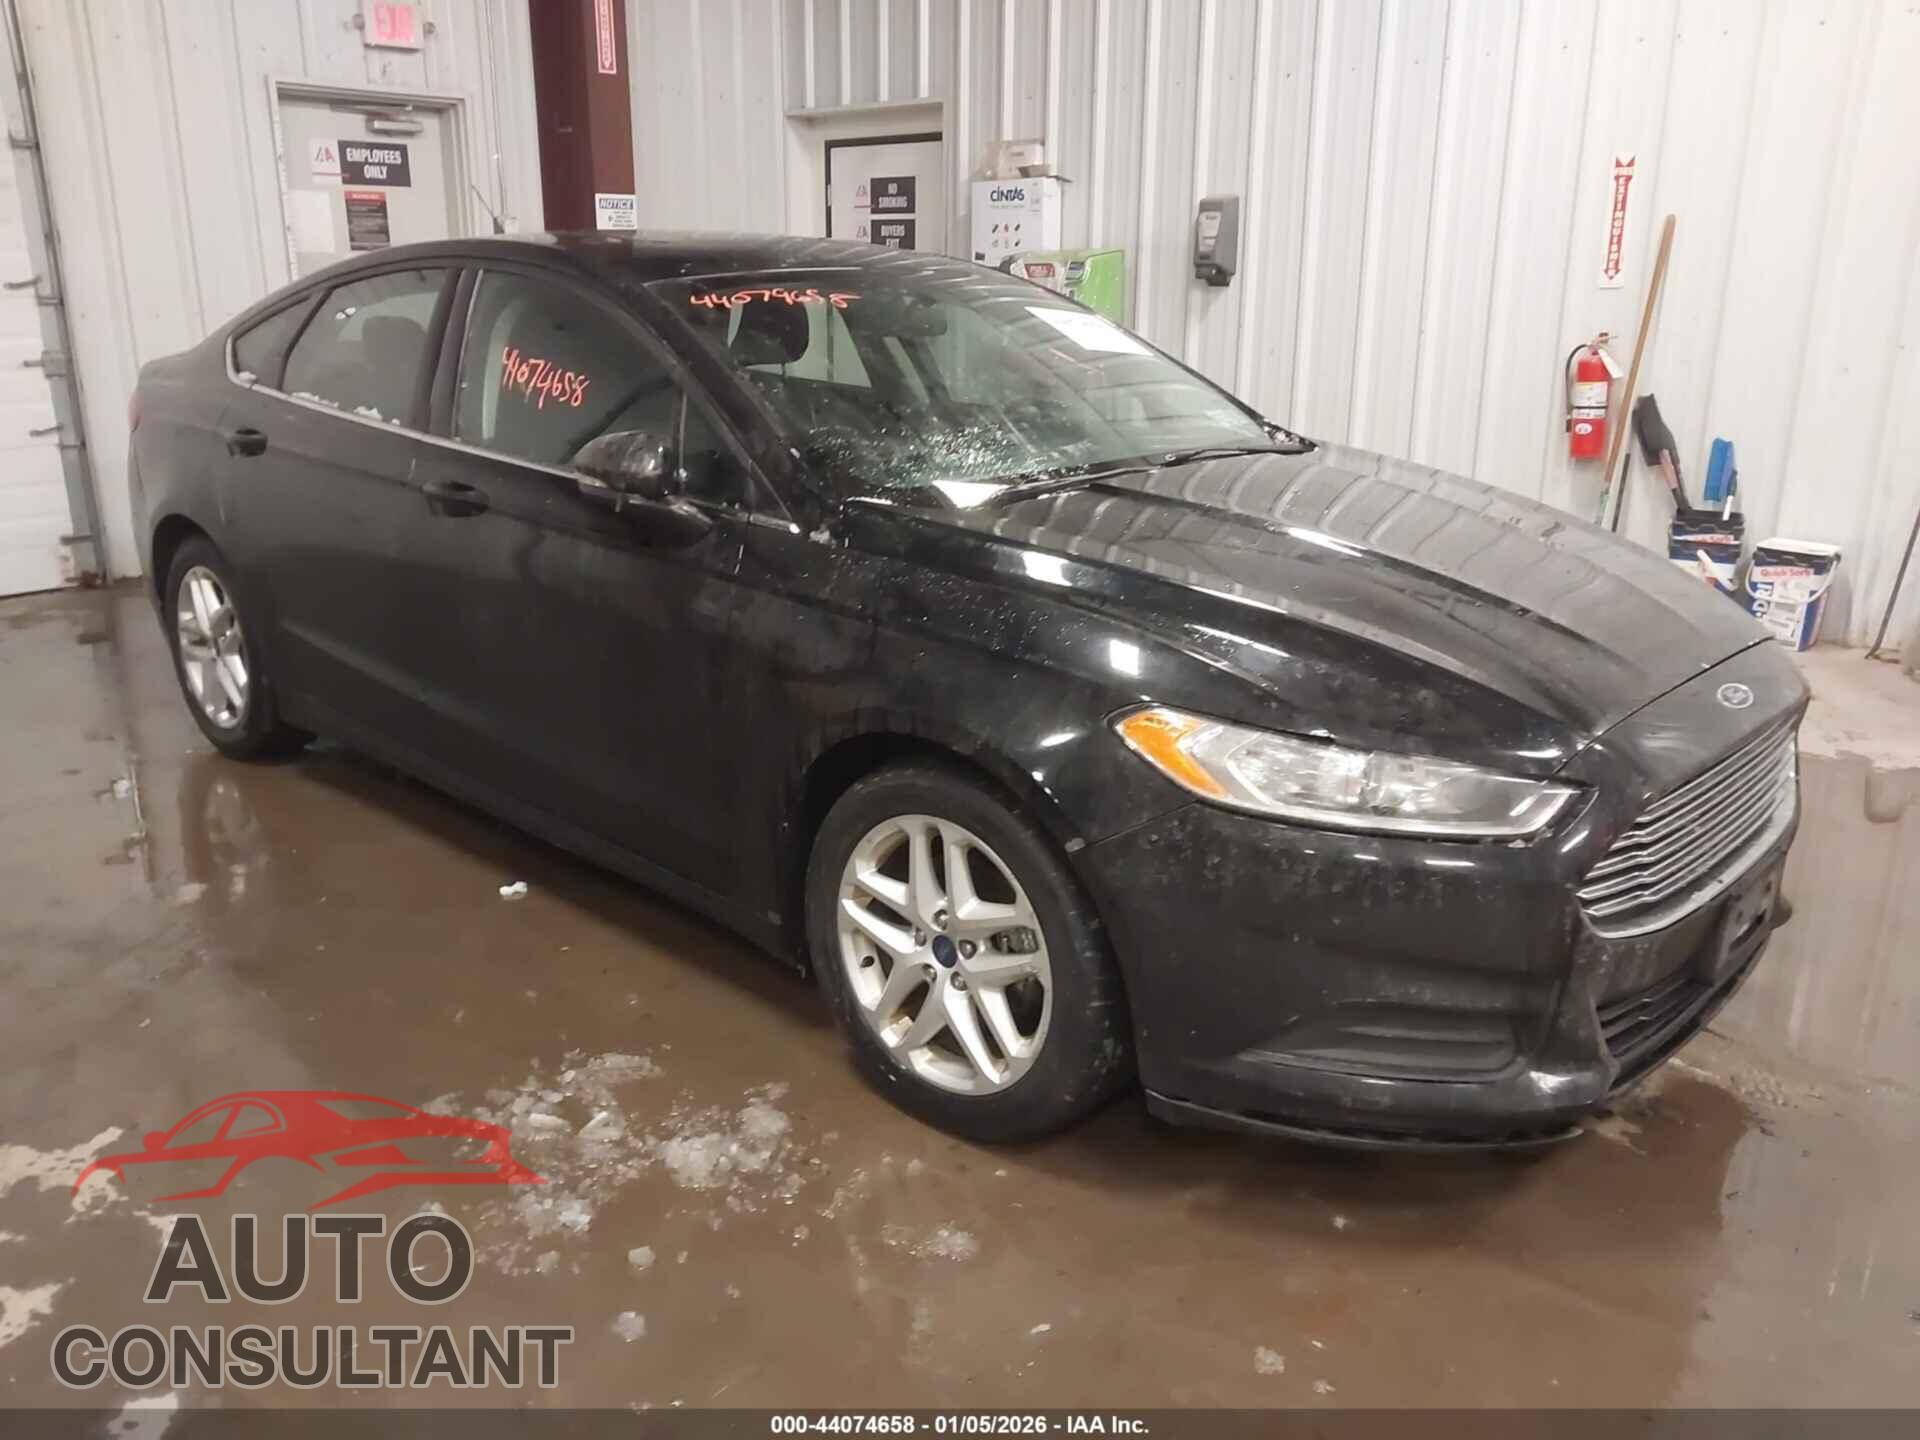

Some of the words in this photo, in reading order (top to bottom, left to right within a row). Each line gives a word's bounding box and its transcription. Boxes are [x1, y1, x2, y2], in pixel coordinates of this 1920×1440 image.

[346, 147, 402, 164] EMPLOYEES
[363, 164, 388, 179] ONLY
[600, 198, 634, 209] NOTICE
